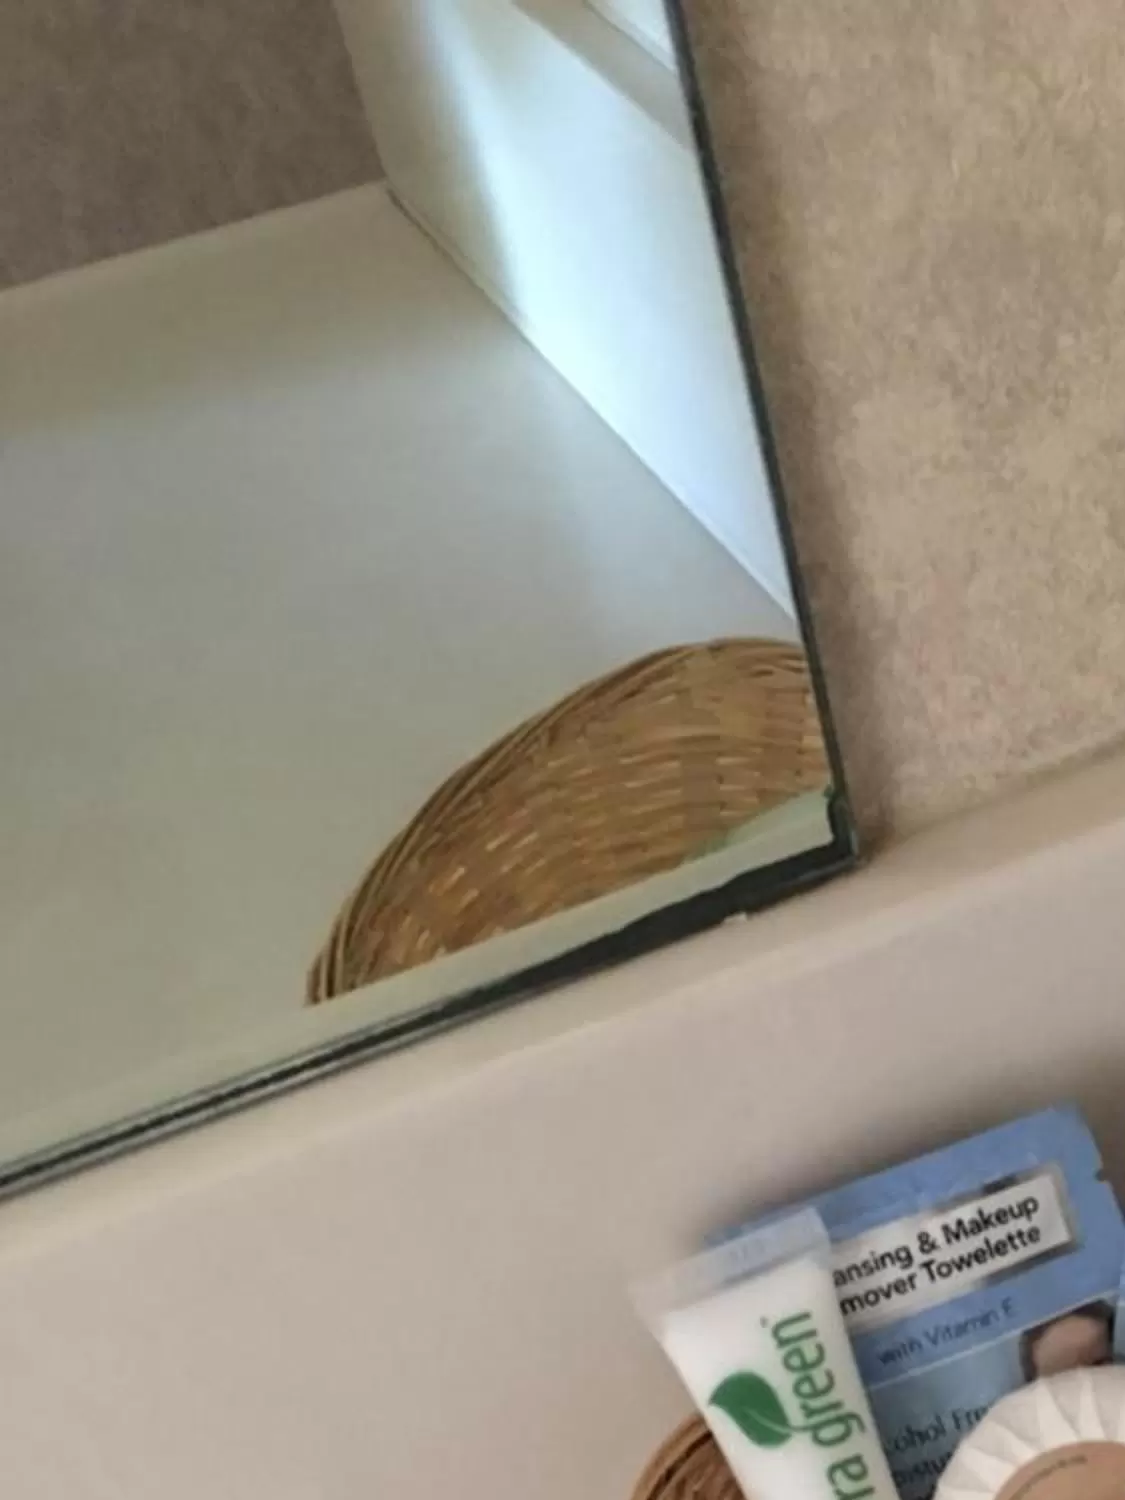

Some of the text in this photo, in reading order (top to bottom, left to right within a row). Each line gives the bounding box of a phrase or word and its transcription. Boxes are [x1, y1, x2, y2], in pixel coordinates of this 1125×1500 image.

[832, 1196, 1039, 1289] ansing & Makeup
[838, 1226, 1041, 1316] mover Towelette
[878, 1296, 1018, 1366] with Vitamin E
[771, 1311, 866, 1447] green
